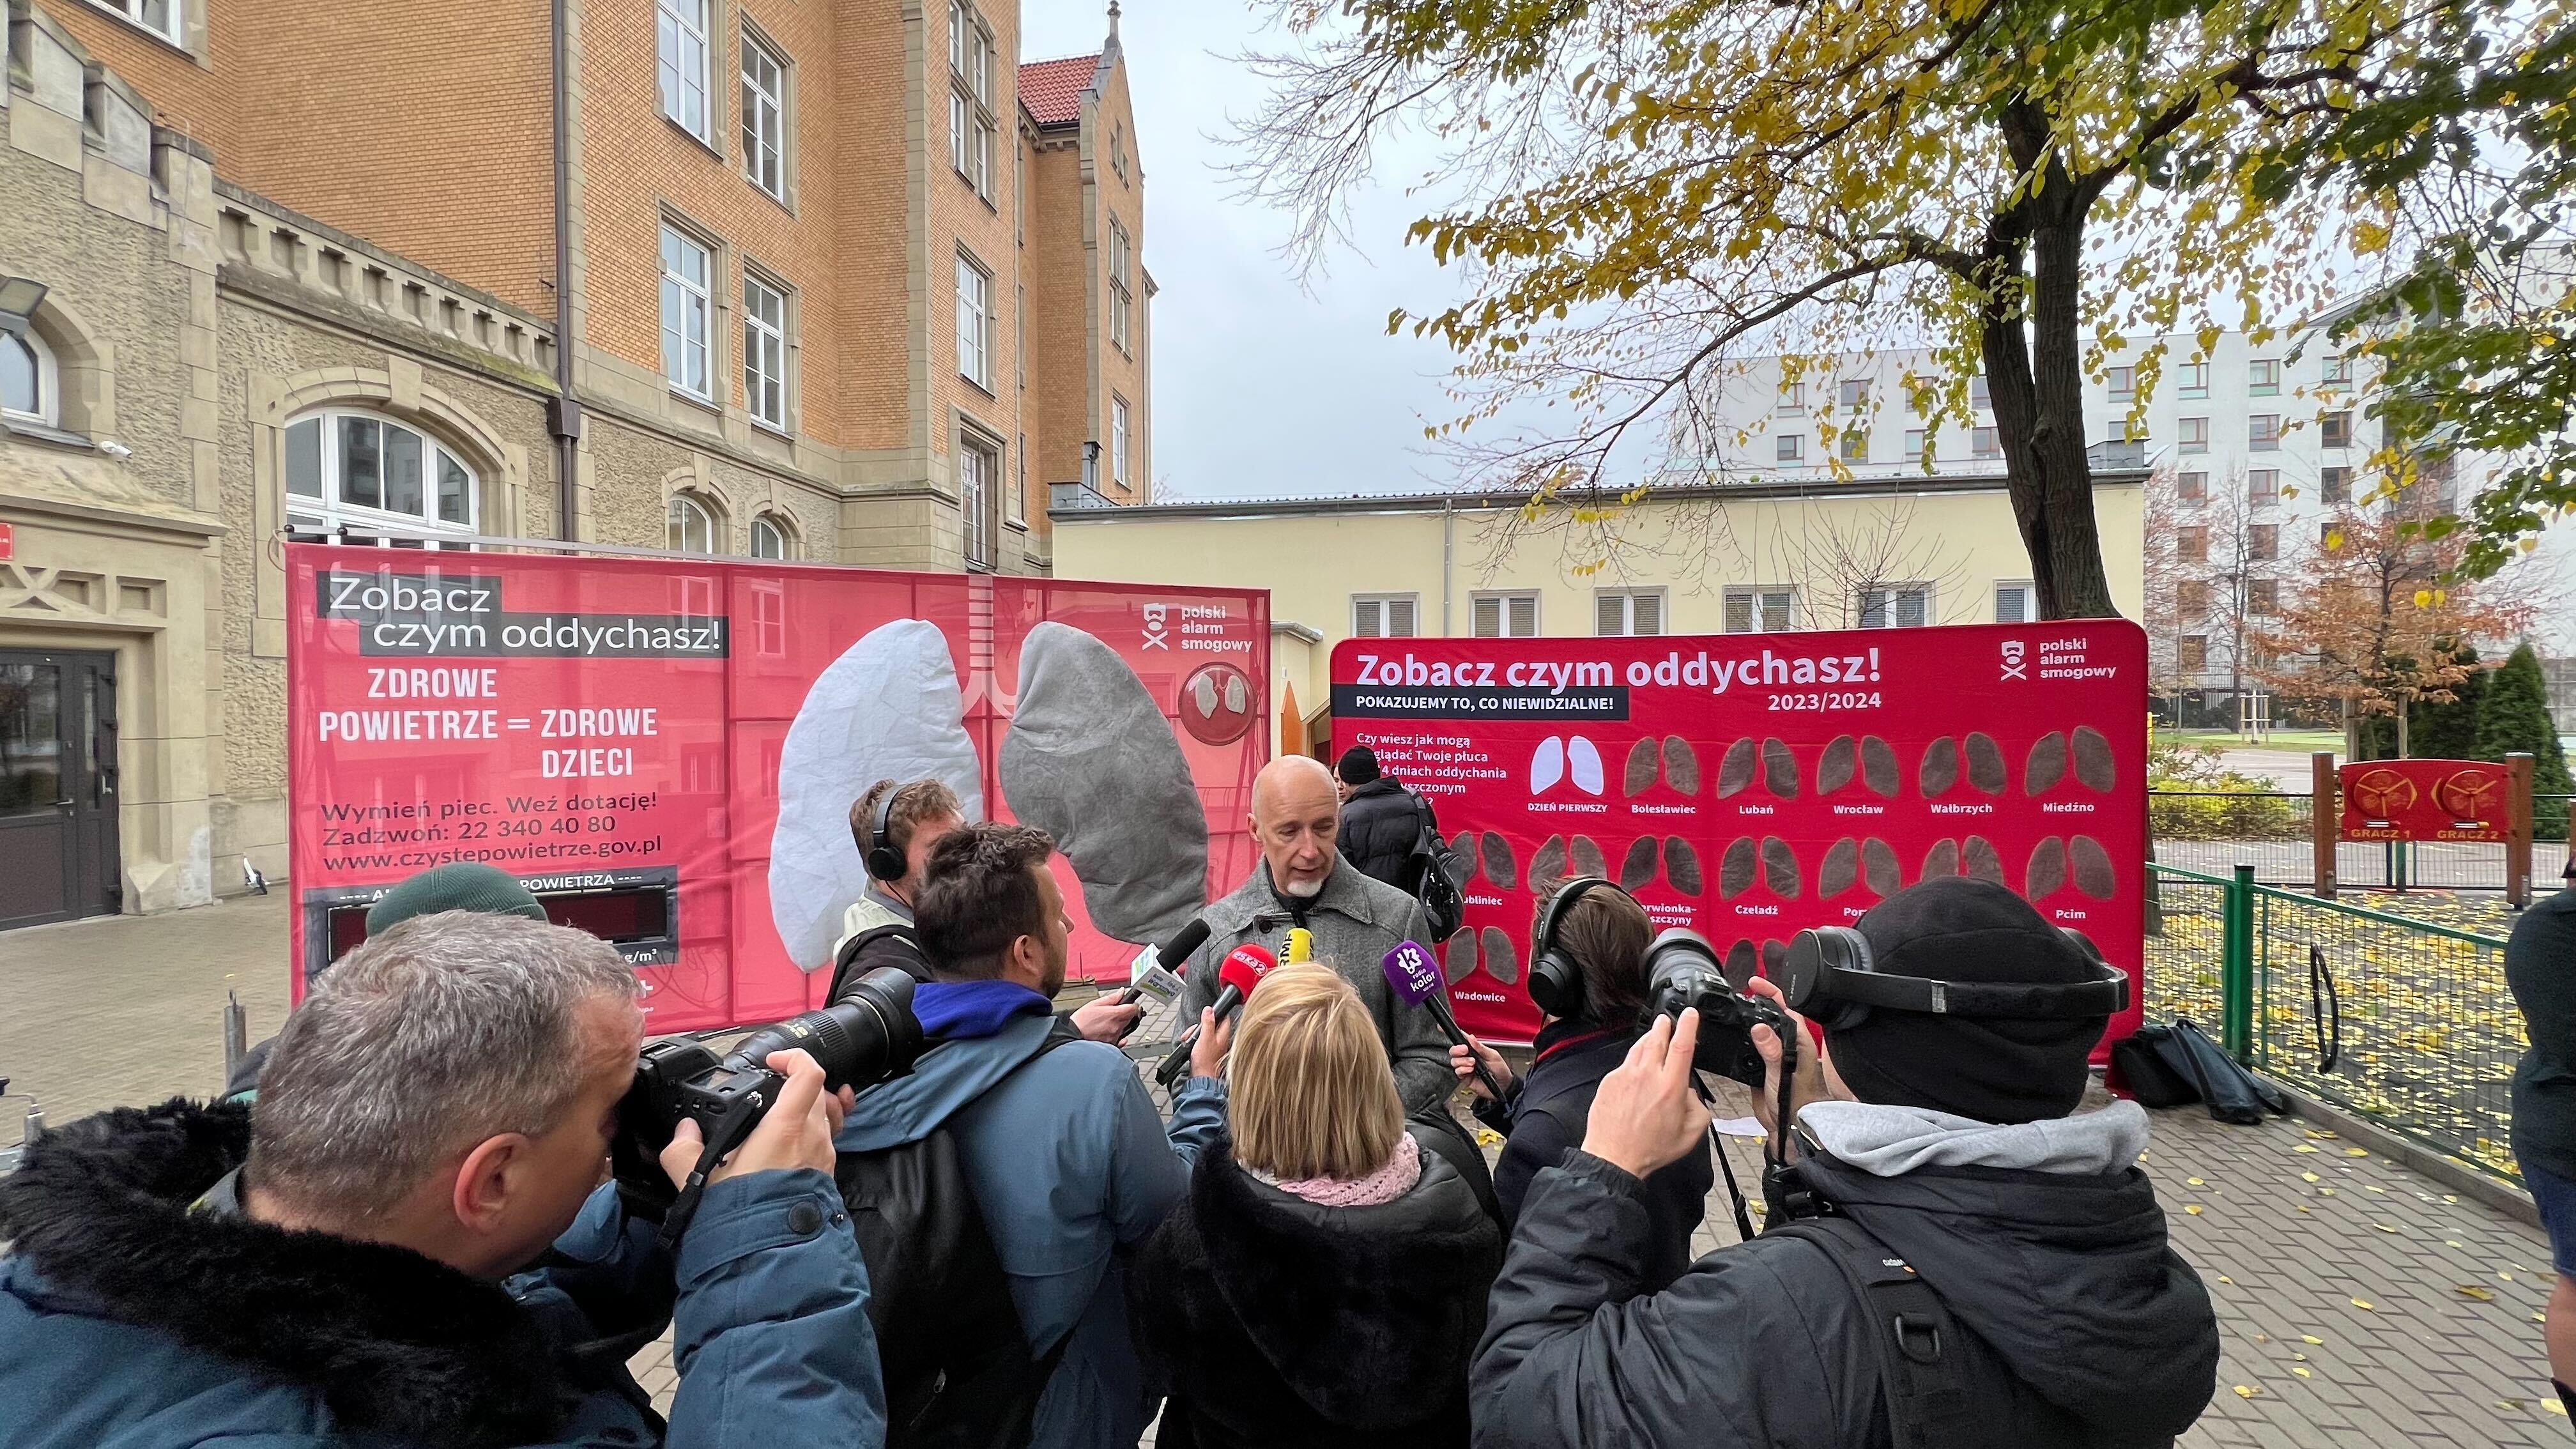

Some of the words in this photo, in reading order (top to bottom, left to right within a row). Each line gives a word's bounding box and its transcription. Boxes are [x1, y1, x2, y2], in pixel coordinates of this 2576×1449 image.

[329, 576, 491, 613] Zobacz
[1181, 605, 1226, 620] polski
[1181, 620, 1224, 634] alarm
[372, 624, 487, 654] czym
[502, 617, 721, 655] oddychasz!
[1181, 638, 1253, 653] smogowy
[2039, 638, 2088, 654] polski
[2039, 652, 2085, 666] alarm
[1356, 653, 1496, 688] Zobacz
[1506, 661, 1614, 695] czym
[1625, 647, 1882, 696] oddychasz!
[2039, 665, 2117, 680] smogowy
[367, 668, 498, 699] ZDROWE
[1356, 696, 1448, 710] POKAZUJEMY
[1451, 697, 1475, 712] TO,
[1478, 697, 1499, 710] CO
[1503, 696, 1614, 711] NIEWIDZIALNE!
[1767, 692, 1882, 713] 2023/2024
[319, 709, 498, 742] POWIETRZE
[507, 718, 530, 730] =
[540, 708, 658, 739] ZDROWE
[1356, 732, 1377, 746] Czy
[1379, 733, 1413, 744] wiesz
[1414, 734, 1434, 747] jak
[1436, 735, 1471, 749] mogą
[541, 747, 632, 779] DZIECI
[1374, 748, 1413, 763] glądać
[1415, 750, 1452, 764] Twoje
[1454, 750, 1489, 764] płuca
[1392, 765, 1432, 778] dniach
[1435, 766, 1507, 780] oddychania
[321, 801, 432, 823] Wymień
[440, 801, 498, 820] piec.
[506, 795, 559, 815] Weź
[565, 792, 657, 812] dotację!
[1528, 801, 1557, 812] DZIEŃ
[1558, 802, 1608, 813] PIERWSZY
[1631, 803, 1696, 815] Bolesławiec
[1738, 803, 1774, 816] Lubań
[1832, 804, 1884, 816] Wrocław
[1930, 803, 1993, 816] Wałbrzych
[2043, 801, 2095, 813] Miedźno
[323, 825, 450, 847] Zadzwoń:
[457, 821, 489, 840] 22
[496, 818, 543, 838] 340
[552, 816, 579, 836] 40
[586, 815, 616, 834] 80
[2350, 829, 2399, 839] GRACZ
[2404, 829, 2411, 839] 1
[2437, 830, 2485, 839] GRACZ
[2490, 830, 2499, 839] 2
[323, 836, 661, 871] www.czystepowietrze.gov.pl
[519, 874, 615, 892] POWIETRZA
[1641, 903, 1698, 914] erwionka-
[1735, 903, 1779, 916] Czeladź
[2055, 908, 2087, 920] Pcim
[1650, 916, 1692, 926] szczyny
[1409, 971, 1436, 992] kolor
[1455, 990, 1506, 1003] Wadowice
